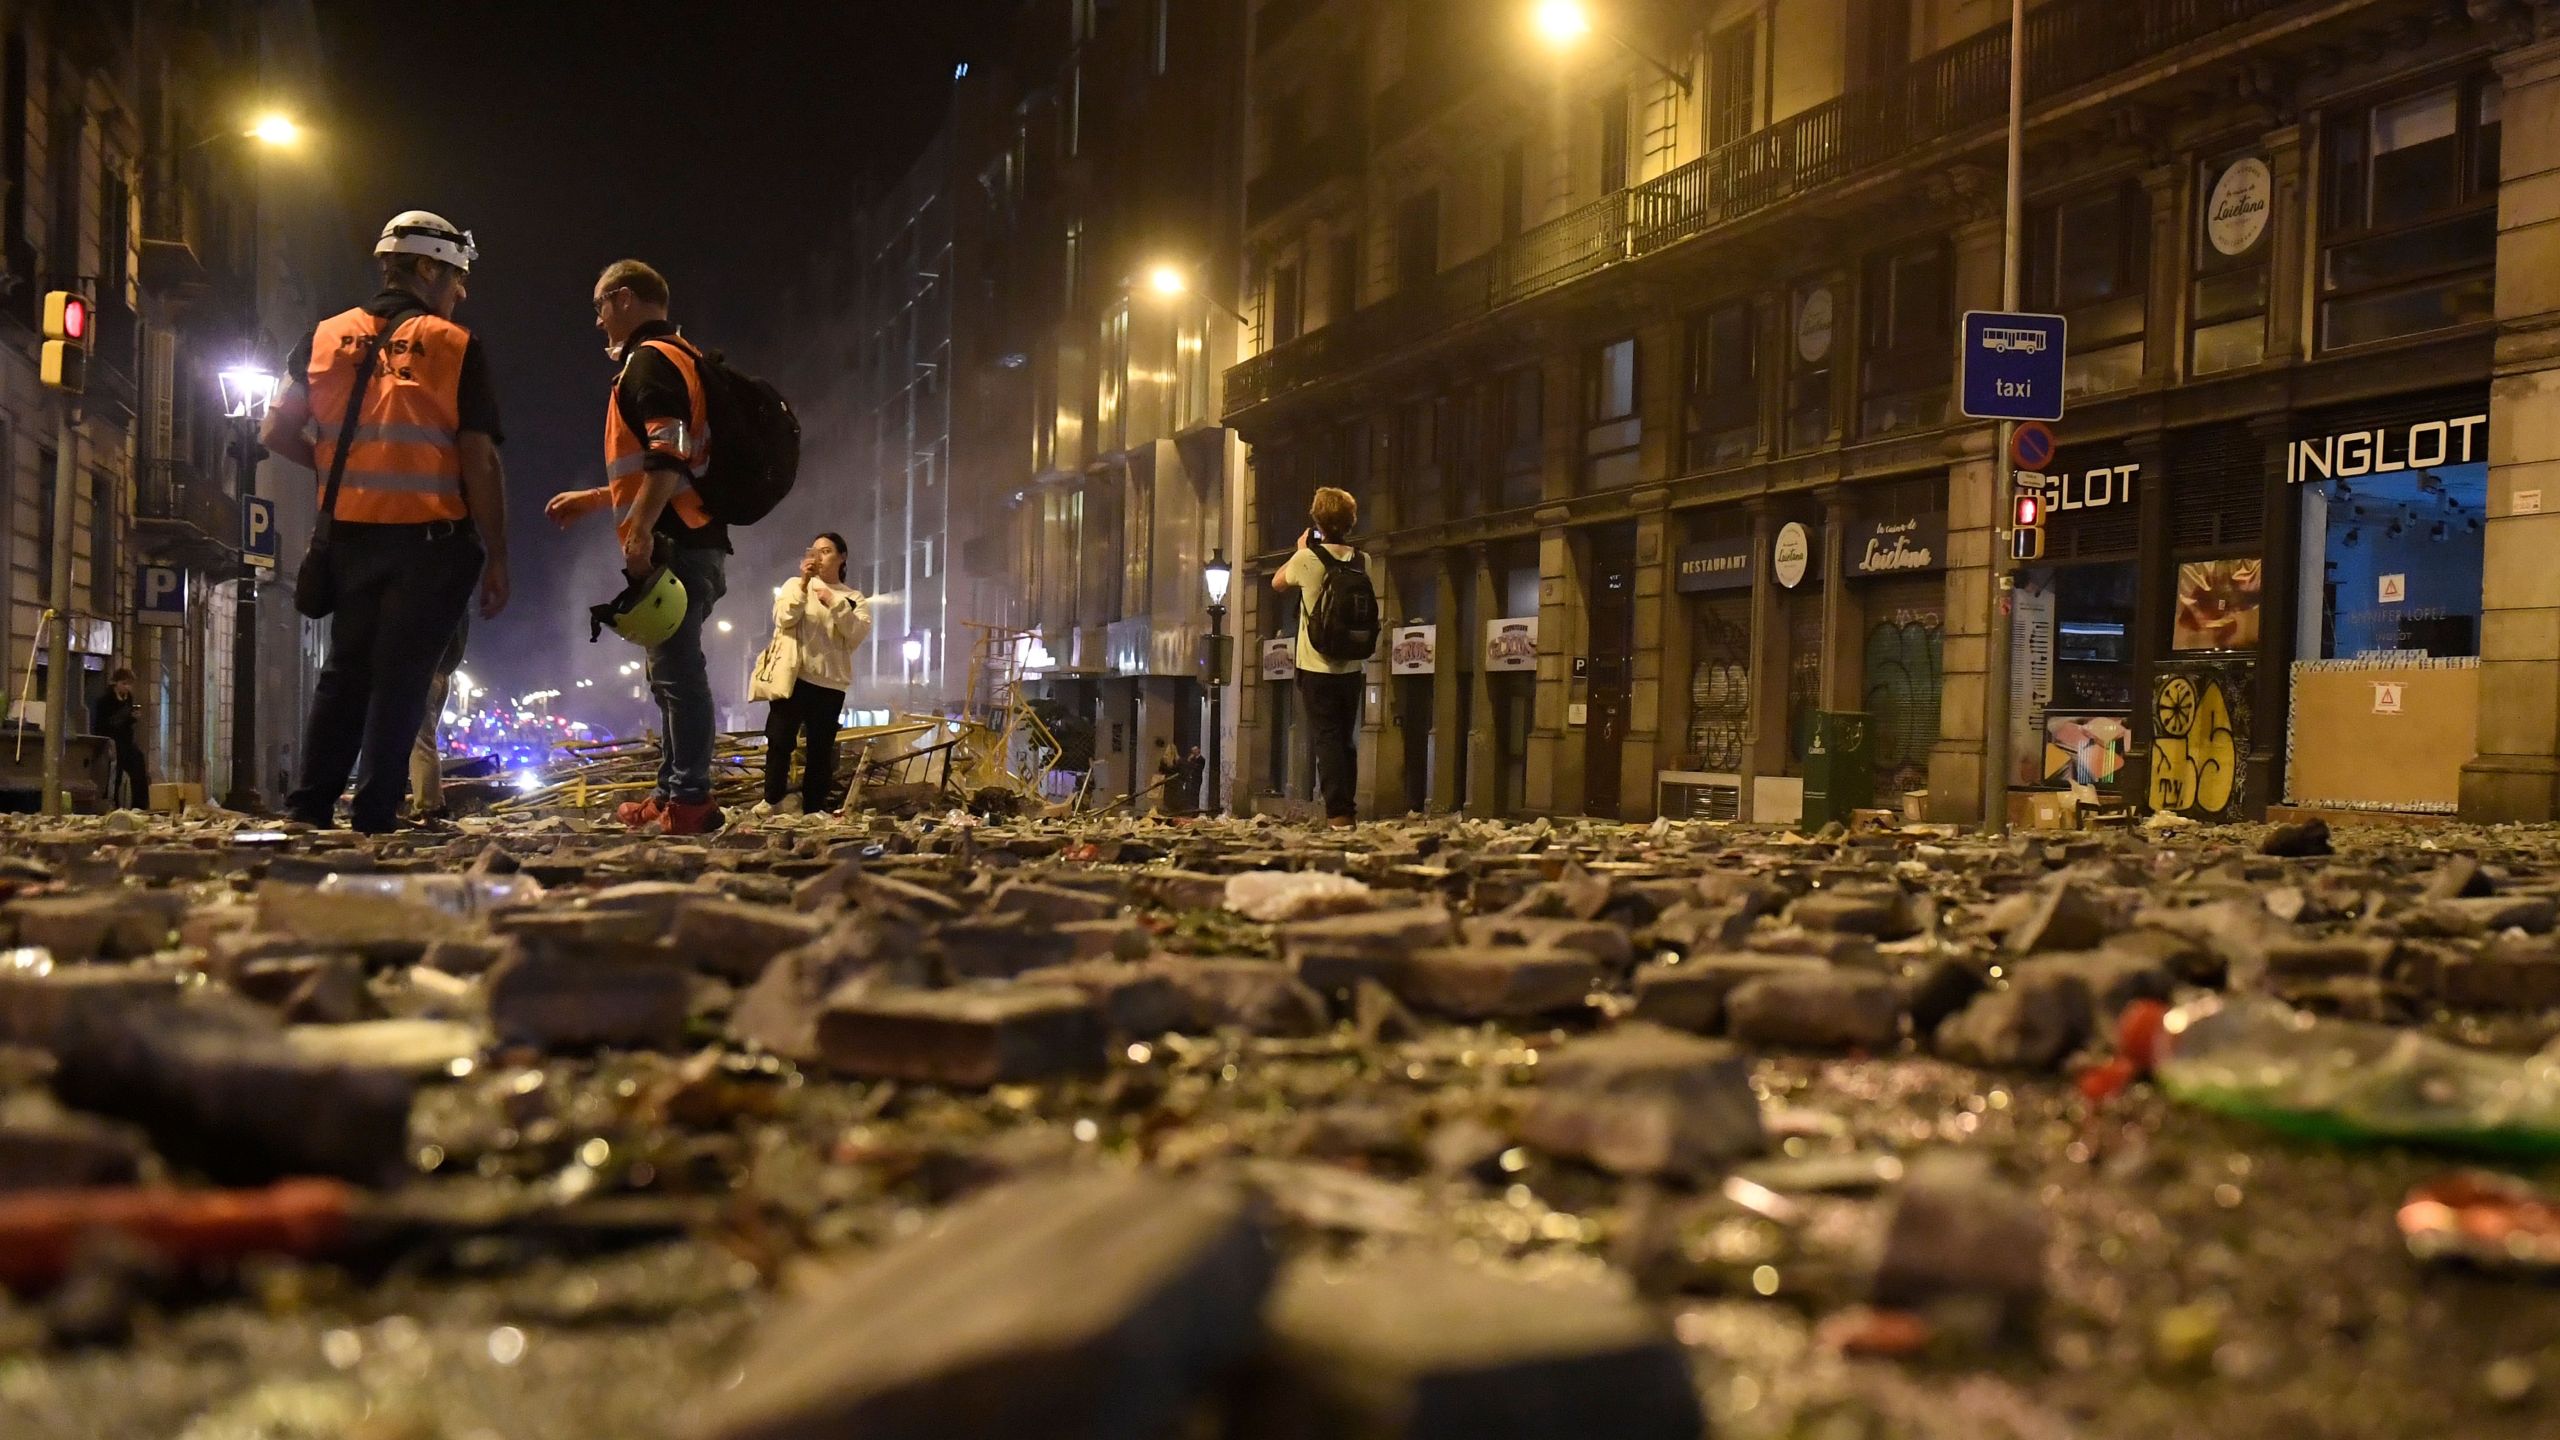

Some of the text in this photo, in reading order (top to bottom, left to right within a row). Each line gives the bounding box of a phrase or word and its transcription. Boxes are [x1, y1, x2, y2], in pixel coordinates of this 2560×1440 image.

[2213, 195, 2264, 221] Laietana
[1996, 377, 2032, 398] taxi
[2287, 414, 2487, 484] INGLOT
[250, 502, 269, 547] P
[1682, 554, 1748, 575] RESTAURANT
[1859, 535, 1933, 573] Laietana
[145, 568, 177, 608] P
[1575, 659, 1586, 671] P
